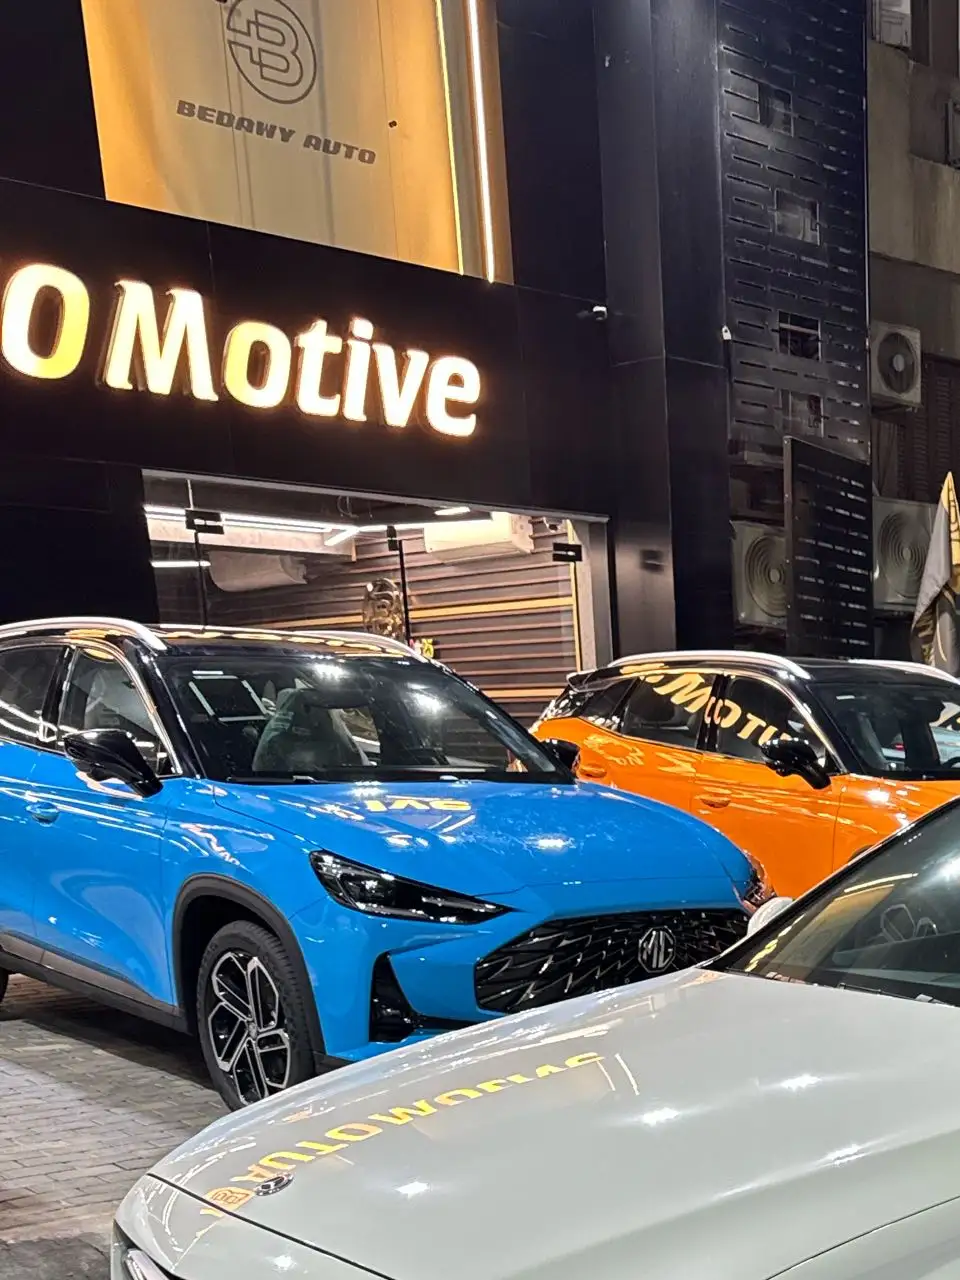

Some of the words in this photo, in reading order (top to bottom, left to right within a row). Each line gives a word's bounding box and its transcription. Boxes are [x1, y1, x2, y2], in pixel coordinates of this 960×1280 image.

[175, 99, 296, 143] BEDAWY
[303, 134, 377, 165] AUTO
[641, 929, 675, 970] MG
